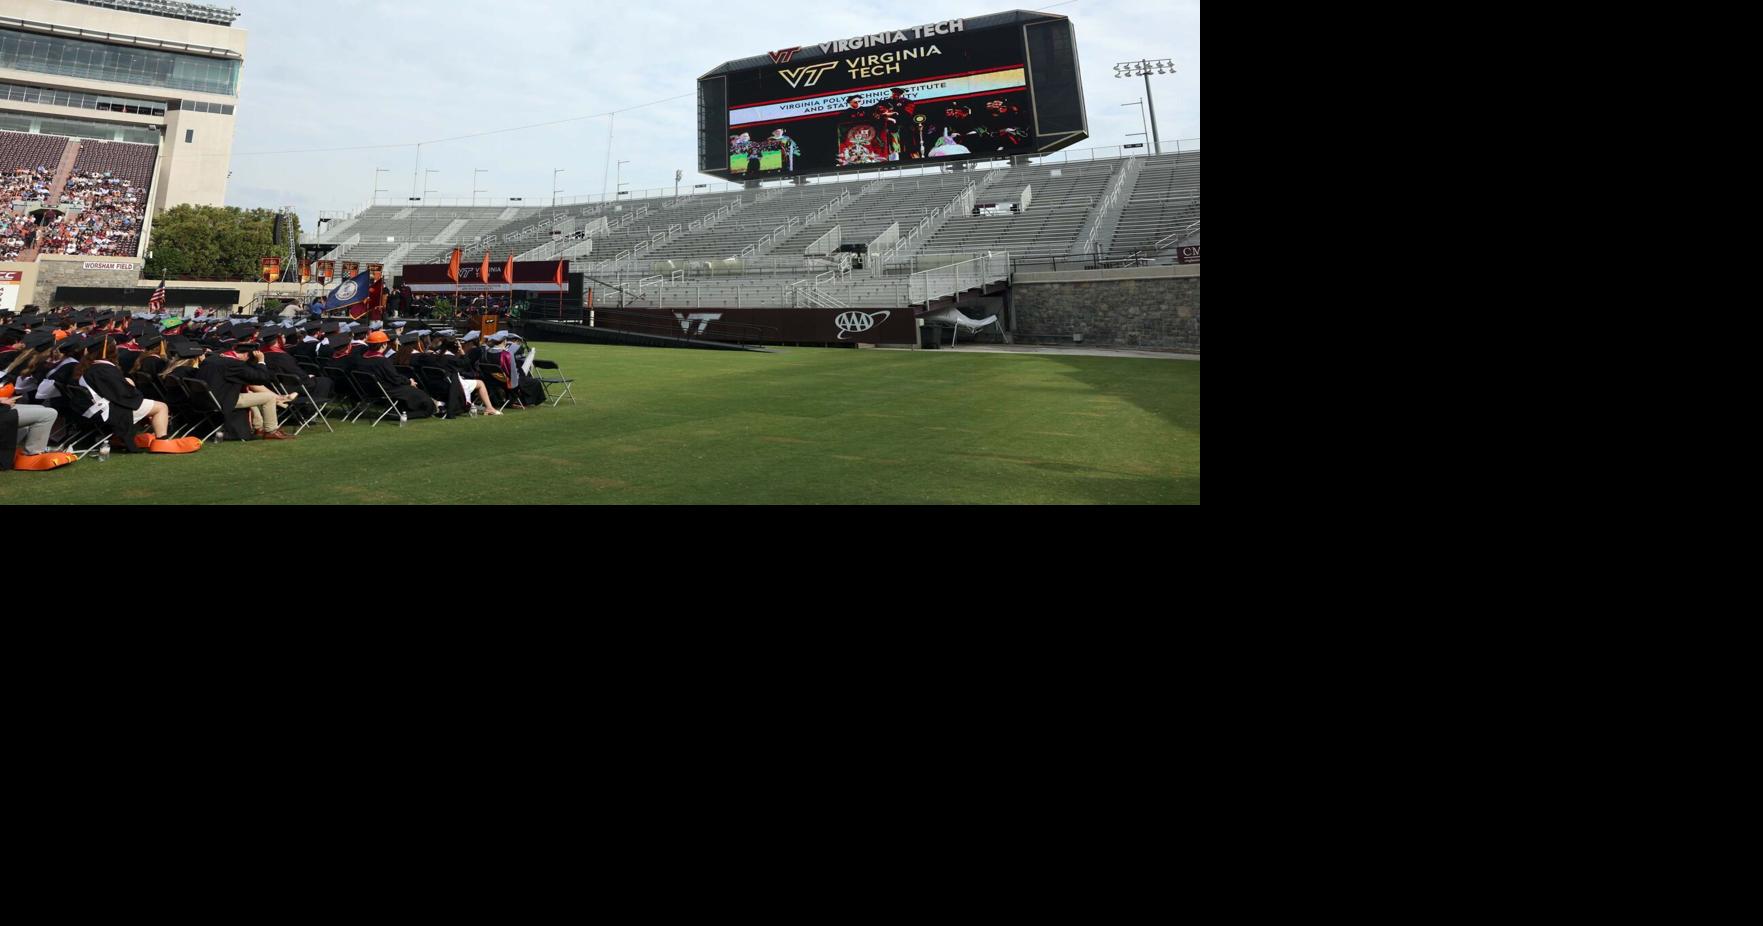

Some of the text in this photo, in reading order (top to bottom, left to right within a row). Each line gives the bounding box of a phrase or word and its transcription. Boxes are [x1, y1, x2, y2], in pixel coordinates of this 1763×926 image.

[818, 18, 964, 54] VIRGINIA TECH
[768, 47, 801, 64] VT
[846, 45, 942, 68] VIRGINIA
[779, 61, 839, 88] VT
[848, 63, 900, 79] TECH
[779, 82, 947, 111] VIRGINIA POLYCHNIC STITUTE
[804, 105, 824, 113] AND
[827, 101, 851, 111] STAT
[673, 311, 723, 335] VT
[839, 312, 872, 331] AAA
